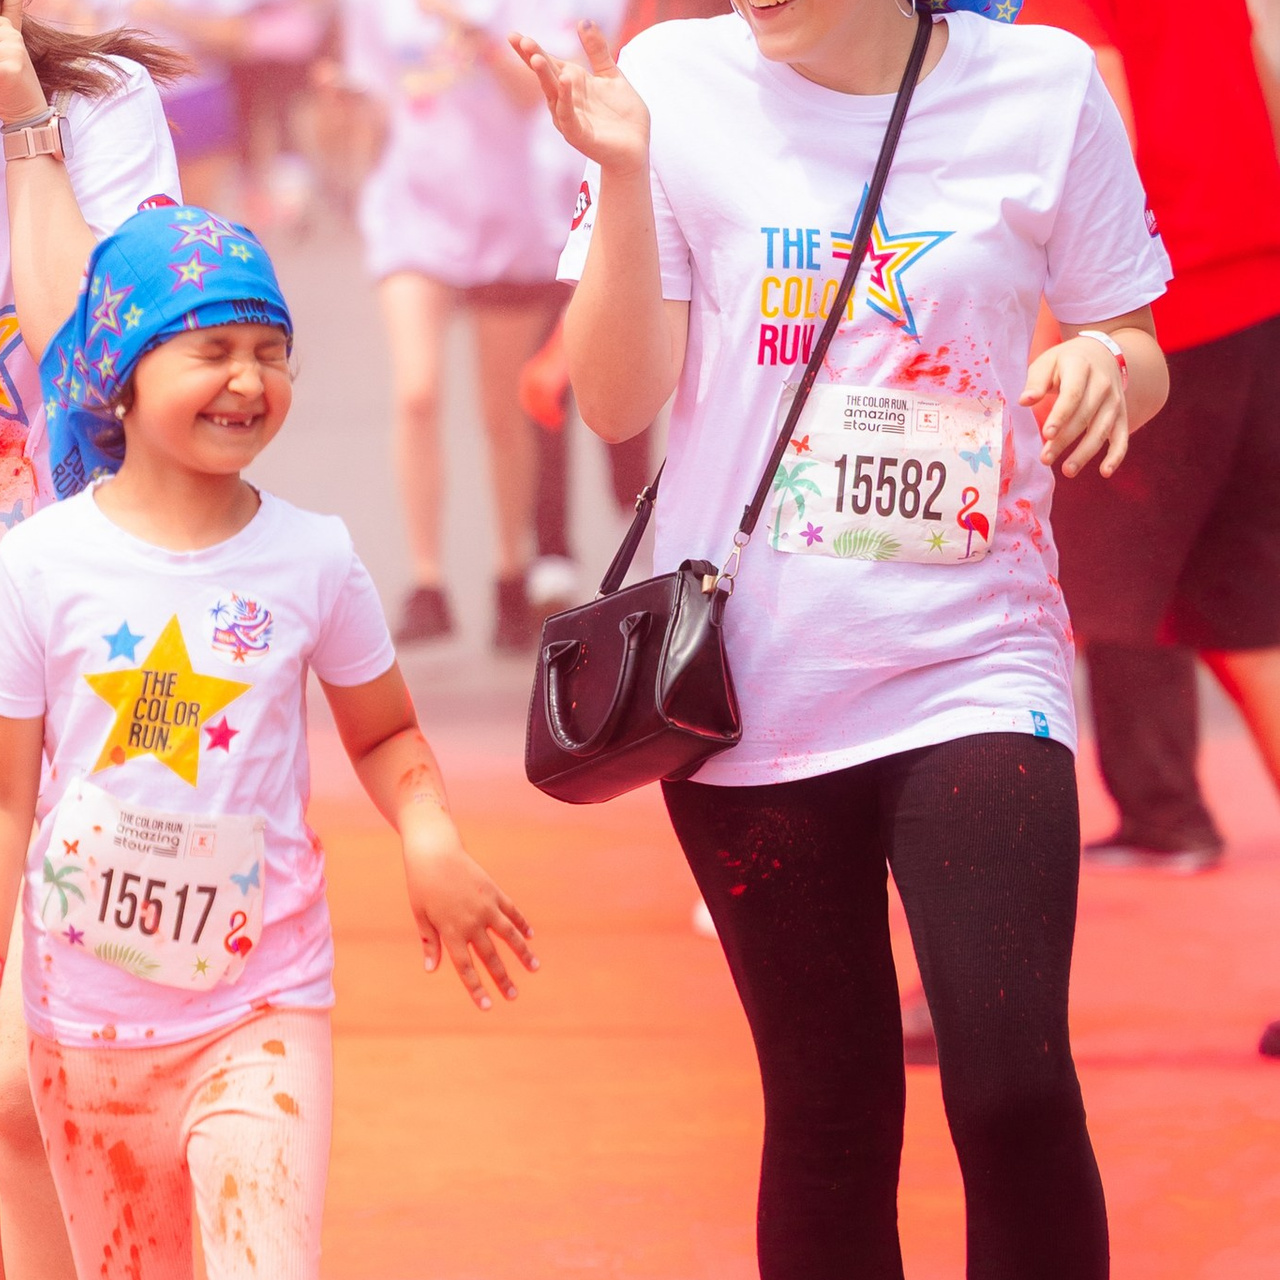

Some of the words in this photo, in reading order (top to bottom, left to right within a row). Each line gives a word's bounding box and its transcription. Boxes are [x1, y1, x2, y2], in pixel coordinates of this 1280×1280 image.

[760, 227, 821, 271] THE
[846, 395, 861, 407] THE
[863, 396, 890, 409] COLOR
[844, 408, 906, 425] amazing
[853, 419, 881, 432] tour
[833, 453, 947, 521] 15582
[140, 669, 178, 700] THE
[132, 697, 202, 729] COLOR
[120, 811, 134, 824] THE
[135, 816, 164, 830] COLOR
[116, 822, 180, 849] amazing
[122, 837, 152, 854] tour
[97, 867, 218, 945] 15517
